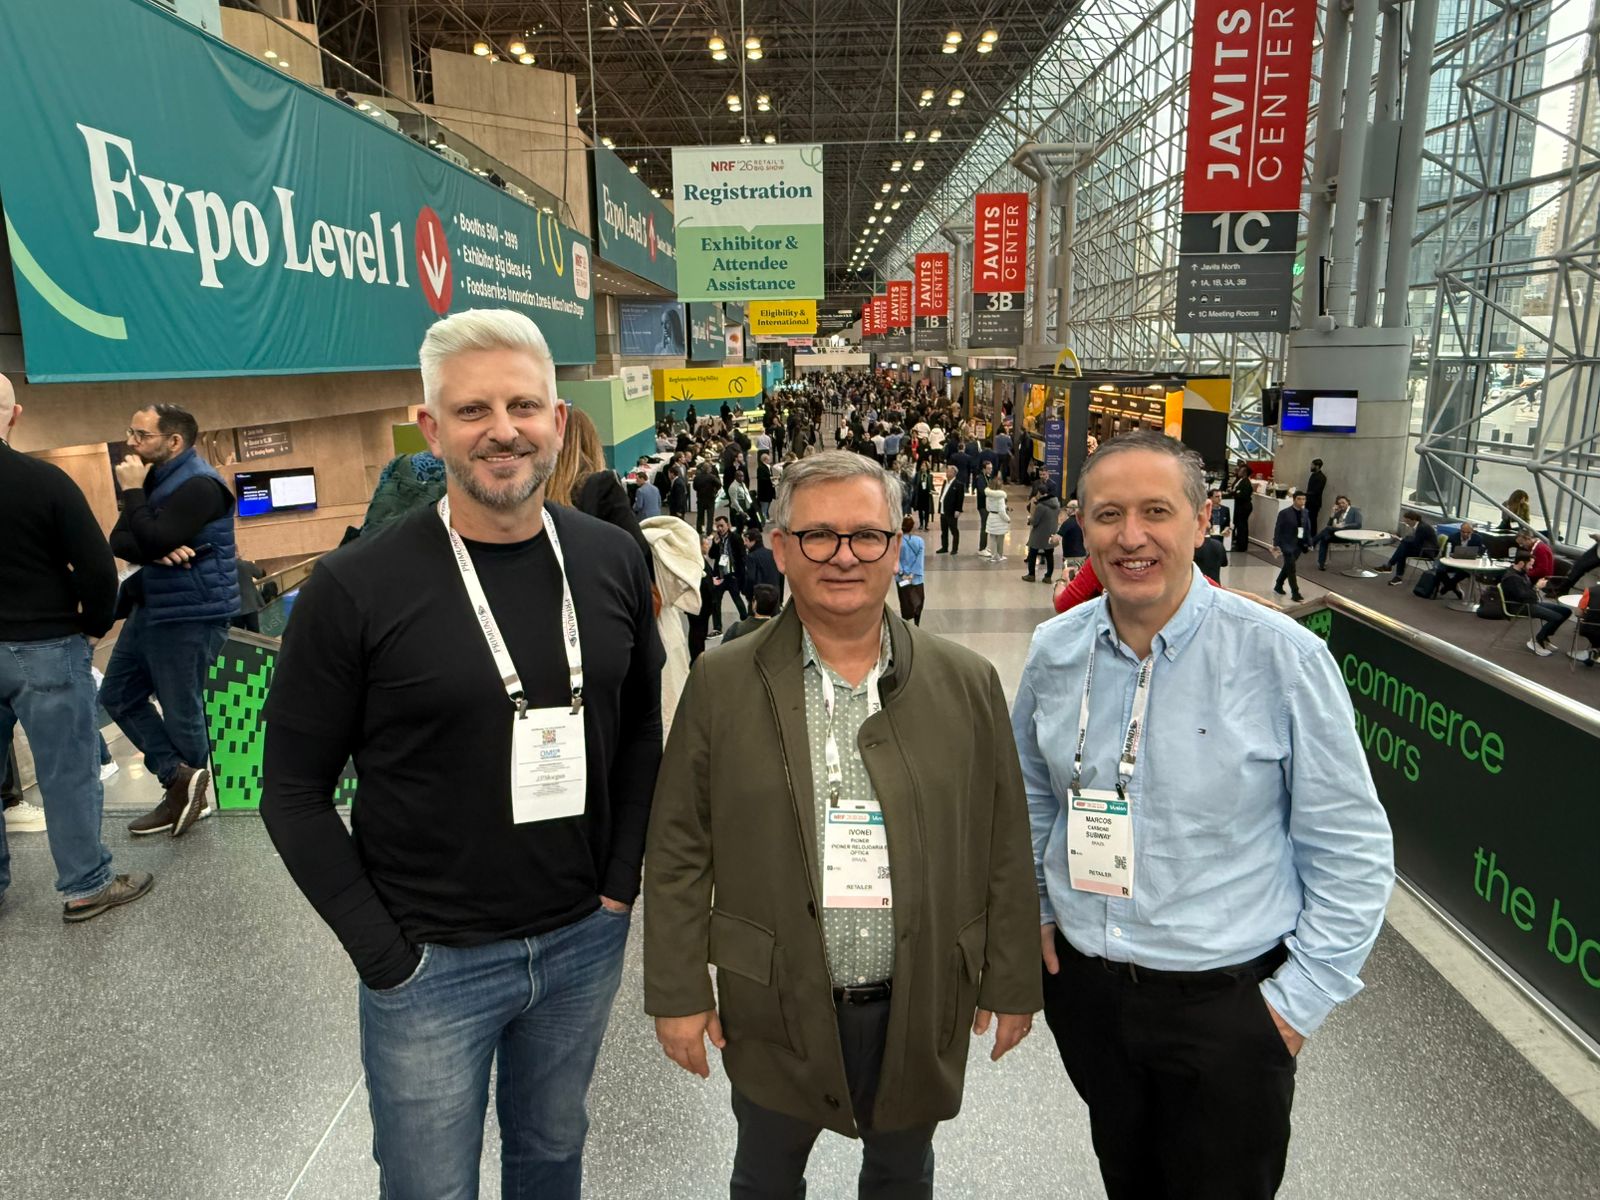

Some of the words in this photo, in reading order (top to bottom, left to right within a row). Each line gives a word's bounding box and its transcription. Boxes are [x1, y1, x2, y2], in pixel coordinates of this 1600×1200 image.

[1206, 8, 1251, 180] JAVITS
[1256, 7, 1296, 182] CENTER
[711, 161, 736, 172] NRF
[76, 122, 270, 289] Expo
[273, 186, 391, 285] Level
[391, 221, 410, 288] 1
[683, 181, 813, 206] Registration
[602, 183, 624, 241] Expo
[460, 212, 486, 239] Booths
[1212, 211, 1271, 255] 1C
[701, 235, 783, 251] Exhibitor
[785, 235, 799, 250] &
[983, 206, 1000, 280] JAVITS
[1004, 205, 1020, 280] CENTER
[463, 244, 495, 270] Exhibitor
[494, 254, 506, 279] Big
[505, 257, 522, 278] Ideas
[712, 256, 789, 272] Attendee
[466, 276, 507, 301] Foodservice
[506, 285, 536, 307] Innovation
[706, 276, 797, 292] Assistance
[920, 261, 932, 308] JAVITS
[934, 260, 944, 308] CENTER
[760, 308, 798, 318] Eligibility
[891, 286, 899, 321] JAVITS
[986, 291, 1013, 311] 3B
[1208, 310, 1235, 318] Meeting
[757, 318, 810, 326] International
[923, 316, 940, 328] 1B
[1342, 653, 1505, 774] commerce
[848, 828, 872, 836] IVONEI
[1085, 815, 1112, 825] MARCOS
[1085, 831, 1112, 840] SUBWAY
[1088, 869, 1112, 877] RETAILER
[881, 897, 890, 906] R
[1122, 886, 1130, 896] R
[1473, 846, 1536, 932] the
[1547, 898, 1600, 988] bo
